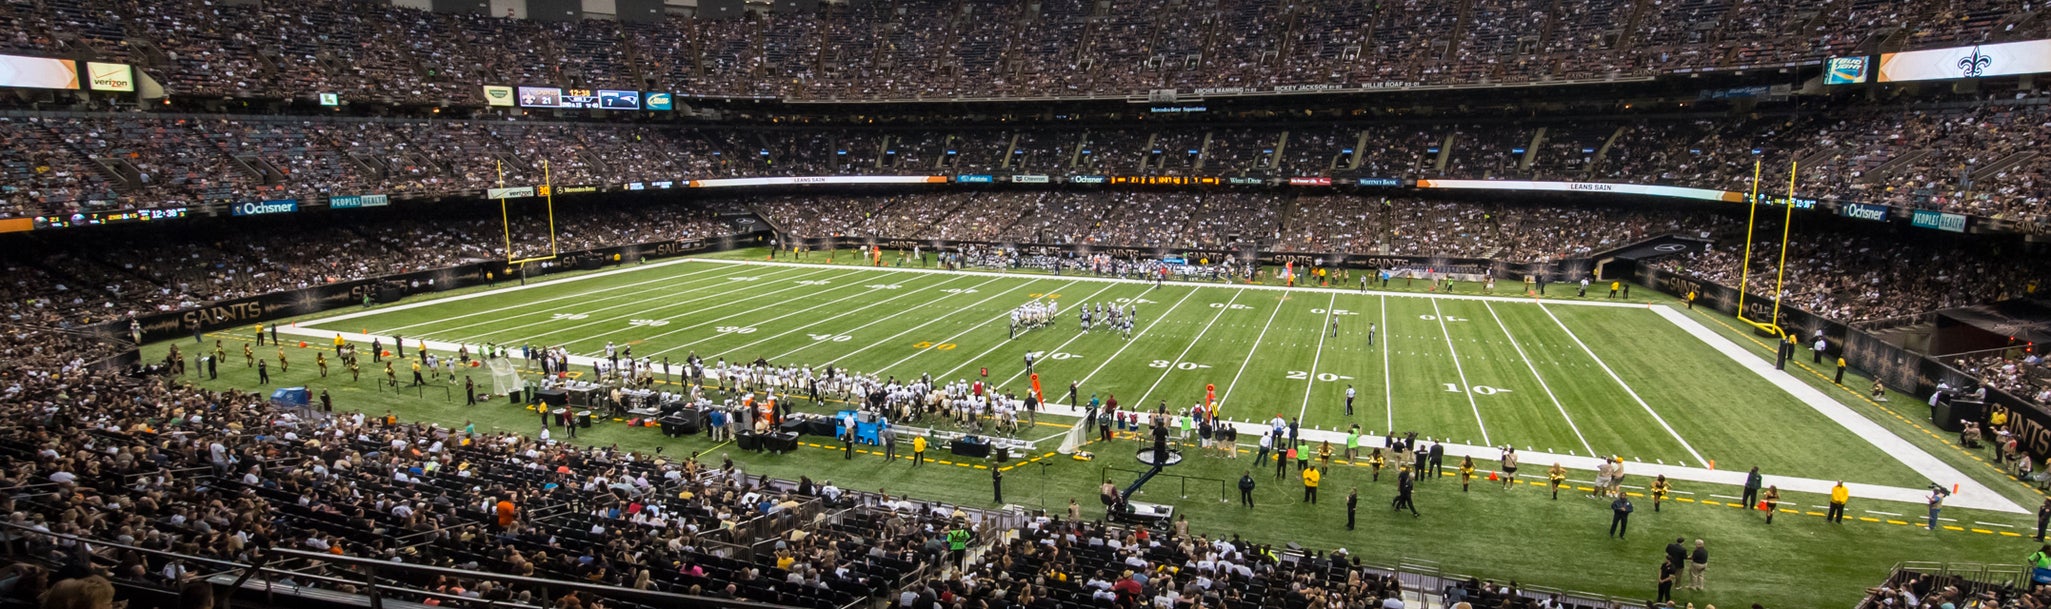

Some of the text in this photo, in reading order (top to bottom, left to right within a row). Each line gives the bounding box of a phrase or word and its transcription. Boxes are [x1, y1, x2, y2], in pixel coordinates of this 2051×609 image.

[94, 79, 128, 87] verizon
[542, 96, 552, 104] 21
[608, 98, 612, 106] 7
[332, 197, 360, 207] PEOPLES
[244, 201, 294, 215] Ochsner
[1848, 204, 1882, 220] Ochsner
[152, 209, 177, 218] 12:38
[1914, 212, 1965, 232] PEOPLES HEALTH
[2014, 222, 2046, 237] SAINTS
[889, 240, 918, 248] SAINTS
[1274, 254, 1313, 264] SAINTS
[1368, 258, 1409, 268] SAINTS
[1670, 277, 1701, 296] SAINTS
[183, 300, 262, 330] SAINTS
[811, 333, 852, 342] 40
[913, 341, 957, 351] 50
[1148, 360, 1198, 371] 30
[1286, 370, 1339, 382] 20
[1443, 383, 1497, 396] 10
